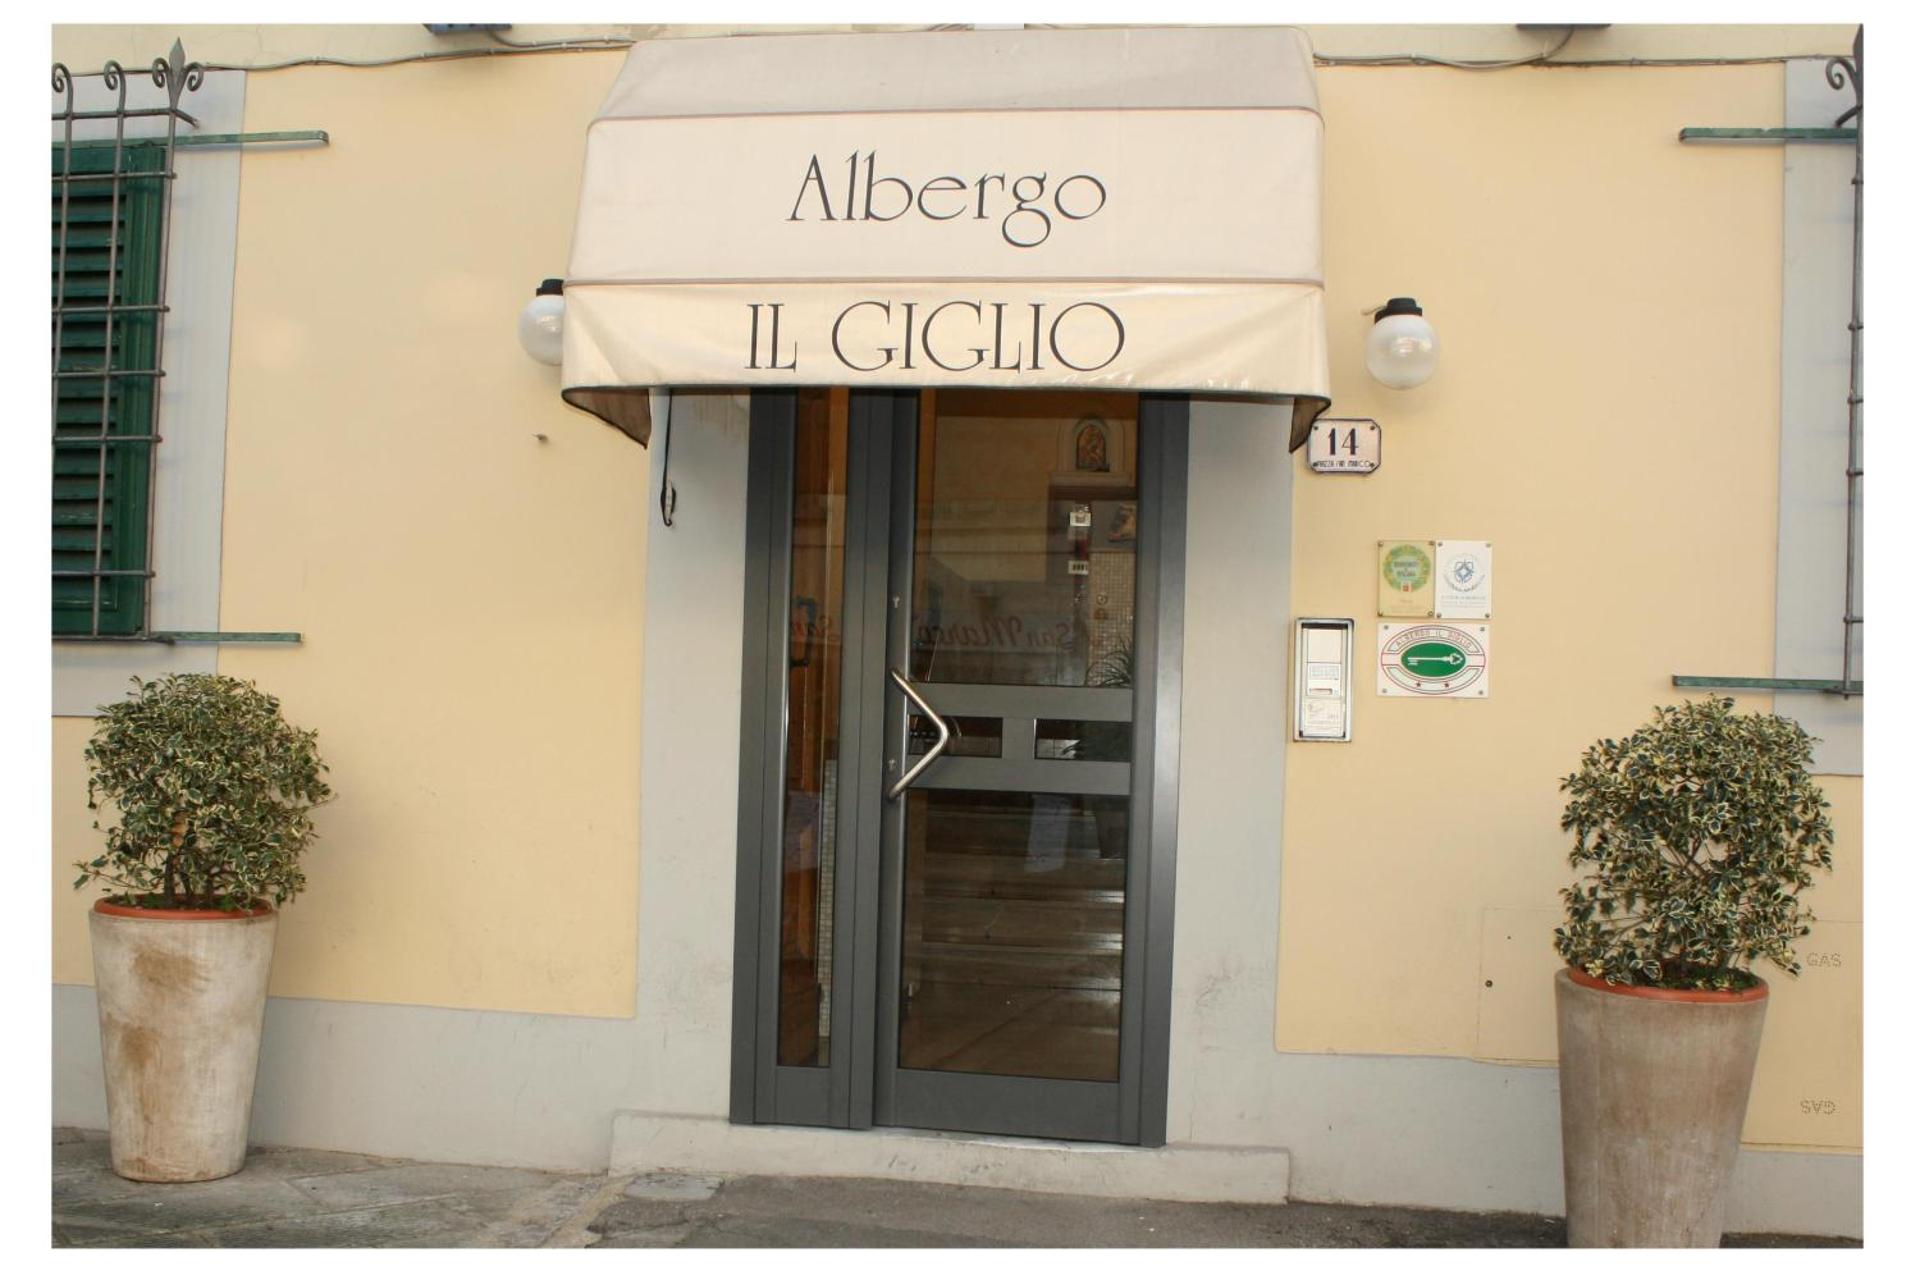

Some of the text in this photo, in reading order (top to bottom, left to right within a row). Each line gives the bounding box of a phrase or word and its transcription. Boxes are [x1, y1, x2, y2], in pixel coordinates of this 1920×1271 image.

[785, 149, 1107, 248] Albergo
[744, 300, 1125, 373] IL GIGLIO
[1327, 427, 1360, 456] 14
[1806, 952, 1842, 968] GAS
